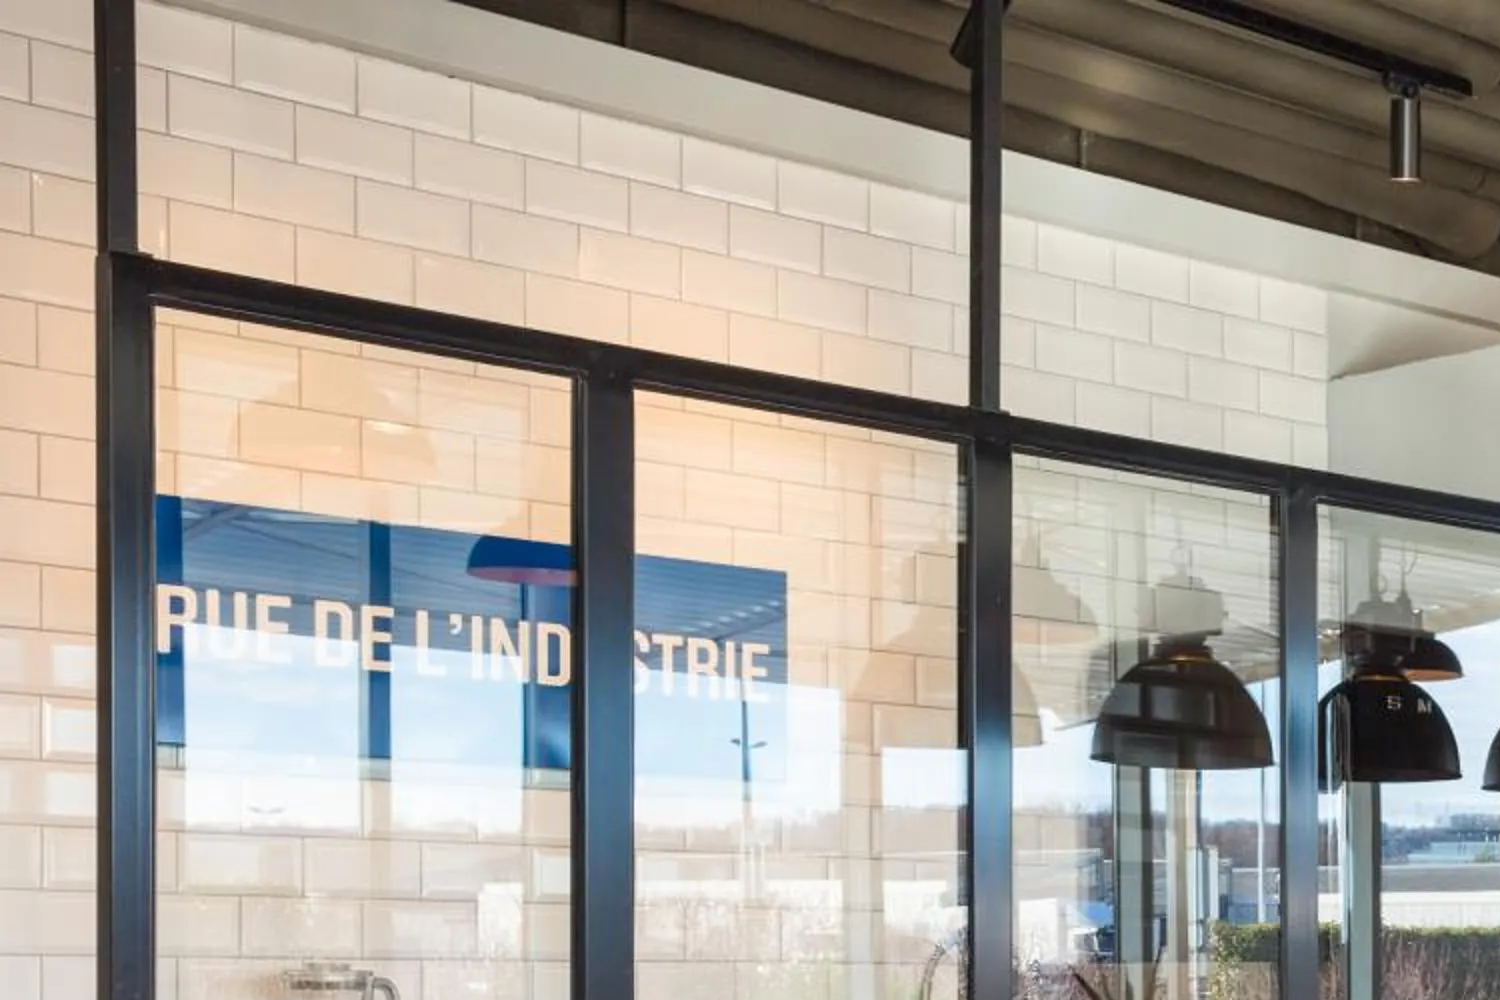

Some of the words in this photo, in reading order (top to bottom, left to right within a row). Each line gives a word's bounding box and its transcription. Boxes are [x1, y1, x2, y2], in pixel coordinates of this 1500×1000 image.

[156, 583, 292, 664] RUE
[314, 599, 395, 672] DE
[415, 609, 771, 703] L'INDSTRIE
